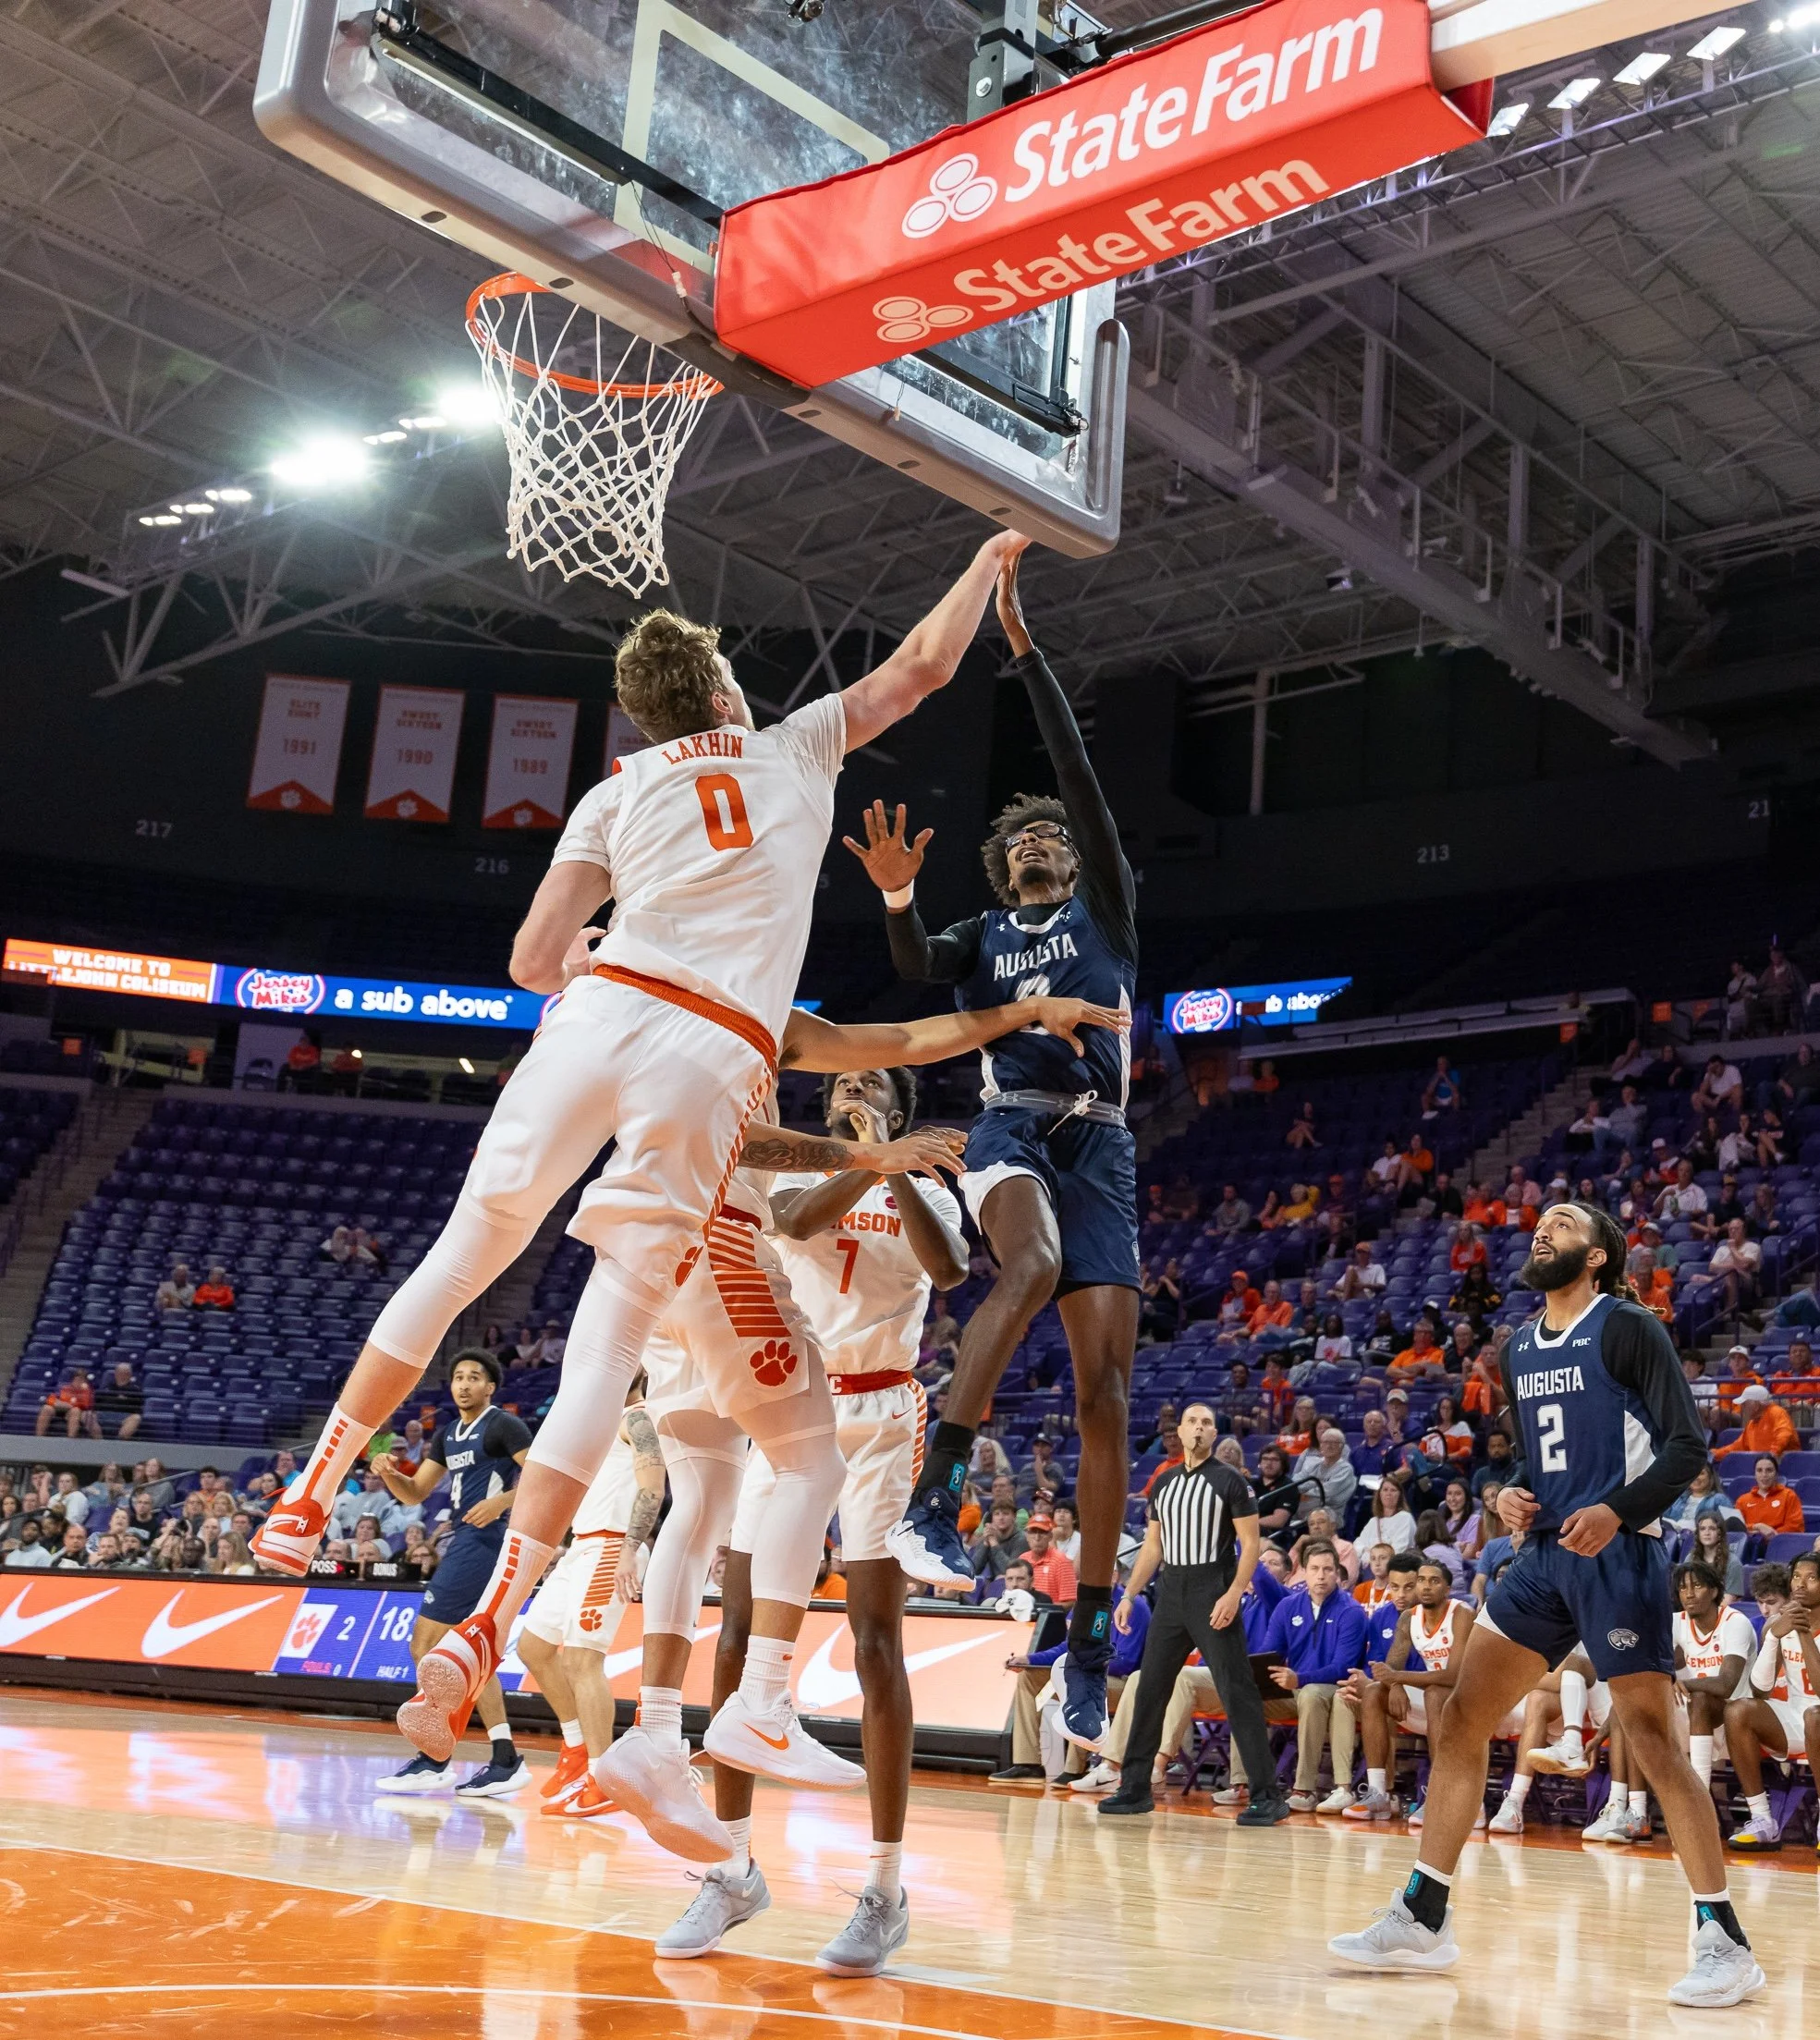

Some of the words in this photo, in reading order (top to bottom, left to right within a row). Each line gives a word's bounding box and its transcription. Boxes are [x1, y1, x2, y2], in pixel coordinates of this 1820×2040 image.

[283, 739, 317, 755] 1991
[661, 732, 744, 765] LAKHIN
[695, 773, 754, 851] 0
[1748, 799, 1770, 819] 21
[135, 819, 174, 839] 217
[1416, 843, 1449, 864] 213
[474, 857, 510, 875] 216
[53, 948, 140, 973] WELCOME
[147, 960, 171, 977] TO
[993, 934, 1079, 982] AUGUSTA
[120, 973, 207, 998] COLISEUM
[249, 972, 312, 993] Jersey
[335, 988, 355, 1010] a
[361, 985, 414, 1014] sub
[1180, 996, 1222, 1015] Jersey
[829, 1212, 902, 1238] MSON
[836, 1238, 860, 1294] 7
[1571, 1337, 1592, 1348] PBC
[1517, 1365, 1585, 1401] AUGUSTA
[1536, 1403, 1568, 1473] 2
[311, 1559, 337, 1574] POSS
[373, 1562, 397, 1577] BONUS
[336, 1616, 356, 1641] 2
[379, 1606, 415, 1643] 18.
[333, 1664, 343, 1677] 0
[375, 1665, 402, 1679] HALF
[401, 1666, 409, 1679] 1
